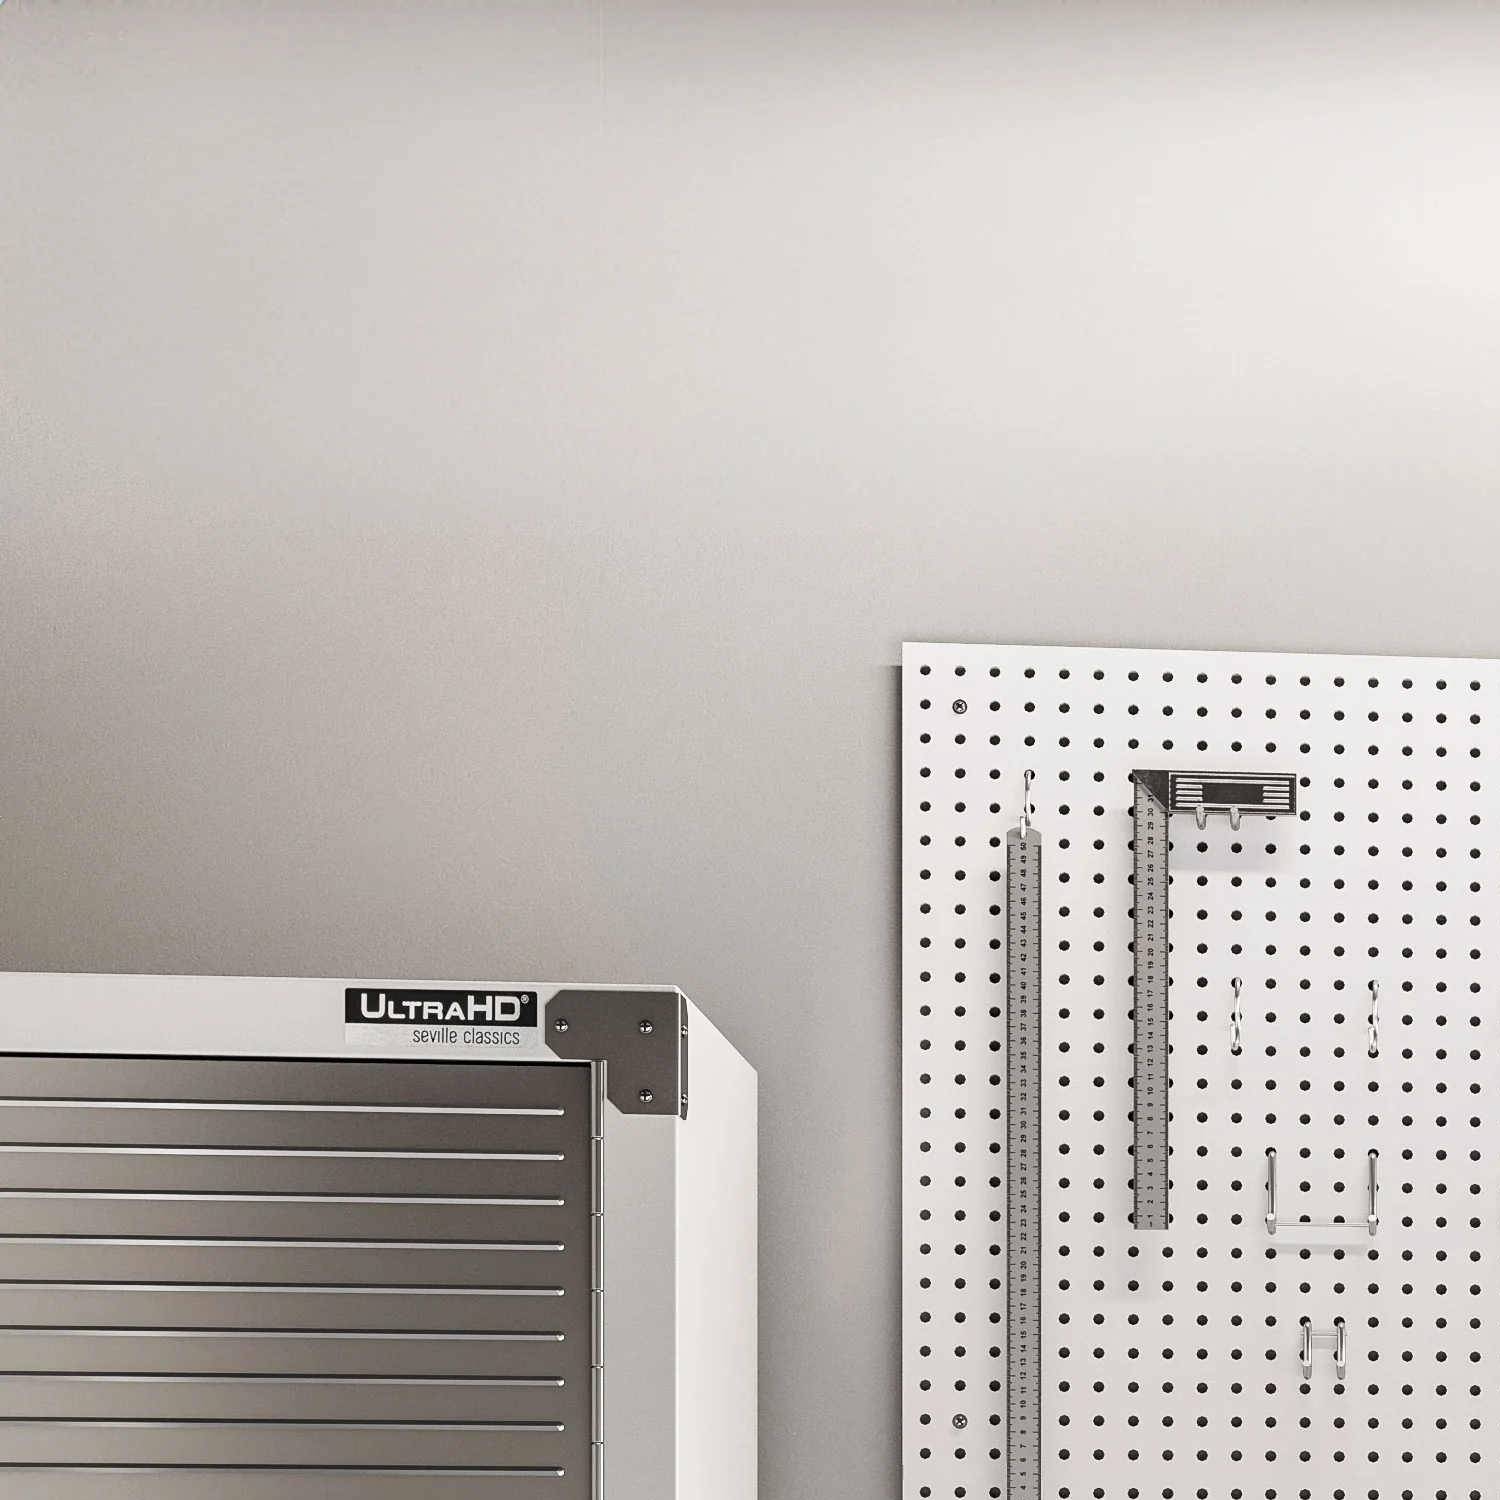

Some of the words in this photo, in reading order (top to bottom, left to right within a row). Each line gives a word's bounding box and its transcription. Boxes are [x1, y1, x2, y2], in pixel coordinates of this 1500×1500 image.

[1147, 807, 1154, 816] 30
[1147, 821, 1154, 830] 29
[1147, 836, 1154, 845] 28
[1020, 841, 1027, 850] 50
[1147, 849, 1154, 858] 27
[1020, 854, 1027, 864] 49
[1147, 863, 1154, 872] 26
[1020, 868, 1027, 877] 48
[1147, 876, 1154, 886] 25
[1020, 882, 1027, 892] 47
[1147, 891, 1154, 900] 24
[1020, 896, 1027, 906] 46
[1147, 905, 1154, 914] 23
[1020, 911, 1027, 920] 45
[1147, 919, 1154, 928] 22
[1020, 924, 1027, 934] 44
[1147, 933, 1154, 941] 21
[1020, 938, 1027, 948] 43
[1147, 947, 1154, 956] 20
[1020, 952, 1027, 962] 42
[1147, 960, 1154, 969] 19
[1020, 967, 1027, 976] 41
[1147, 975, 1154, 983] 18
[1020, 981, 1027, 990] 40
[1147, 988, 1154, 997] 17
[1020, 994, 1027, 1003] 39
[1147, 1003, 1154, 1012] 16
[1020, 1008, 1027, 1018] 38
[1147, 1017, 1154, 1026] 15
[1020, 1022, 1027, 1031] 37
[413, 1027, 457, 1044] seville
[463, 1028, 520, 1045] classics
[1147, 1031, 1154, 1039] 14
[1020, 1036, 1027, 1045] 36
[1147, 1044, 1154, 1053] 13
[1020, 1050, 1027, 1060] 35
[1147, 1058, 1154, 1067] 12
[1020, 1064, 1027, 1073] 34
[1020, 1078, 1027, 1087] 33
[1147, 1086, 1154, 1095] 10
[1020, 1091, 1027, 1101] 32
[1020, 1107, 1027, 1115] 31
[1020, 1120, 1027, 1129] 30
[1020, 1133, 1027, 1143] 29
[1020, 1148, 1027, 1157] 28
[1020, 1162, 1027, 1171] 27
[1020, 1176, 1027, 1185] 26
[1020, 1189, 1027, 1198] 25
[1020, 1204, 1027, 1213] 24
[1020, 1218, 1027, 1227] 23
[1020, 1231, 1027, 1241] 22
[1020, 1246, 1027, 1254] 21
[1020, 1260, 1027, 1269] 20
[1020, 1273, 1027, 1282] 19
[1020, 1287, 1027, 1296] 18
[1020, 1302, 1027, 1310] 17
[1020, 1315, 1027, 1324] 16
[1020, 1330, 1027, 1339] 15
[1020, 1344, 1027, 1353] 14
[1020, 1357, 1027, 1366] 13
[1020, 1371, 1027, 1380] 12
[1020, 1386, 1027, 1394] 11
[1020, 1399, 1027, 1408] 10
